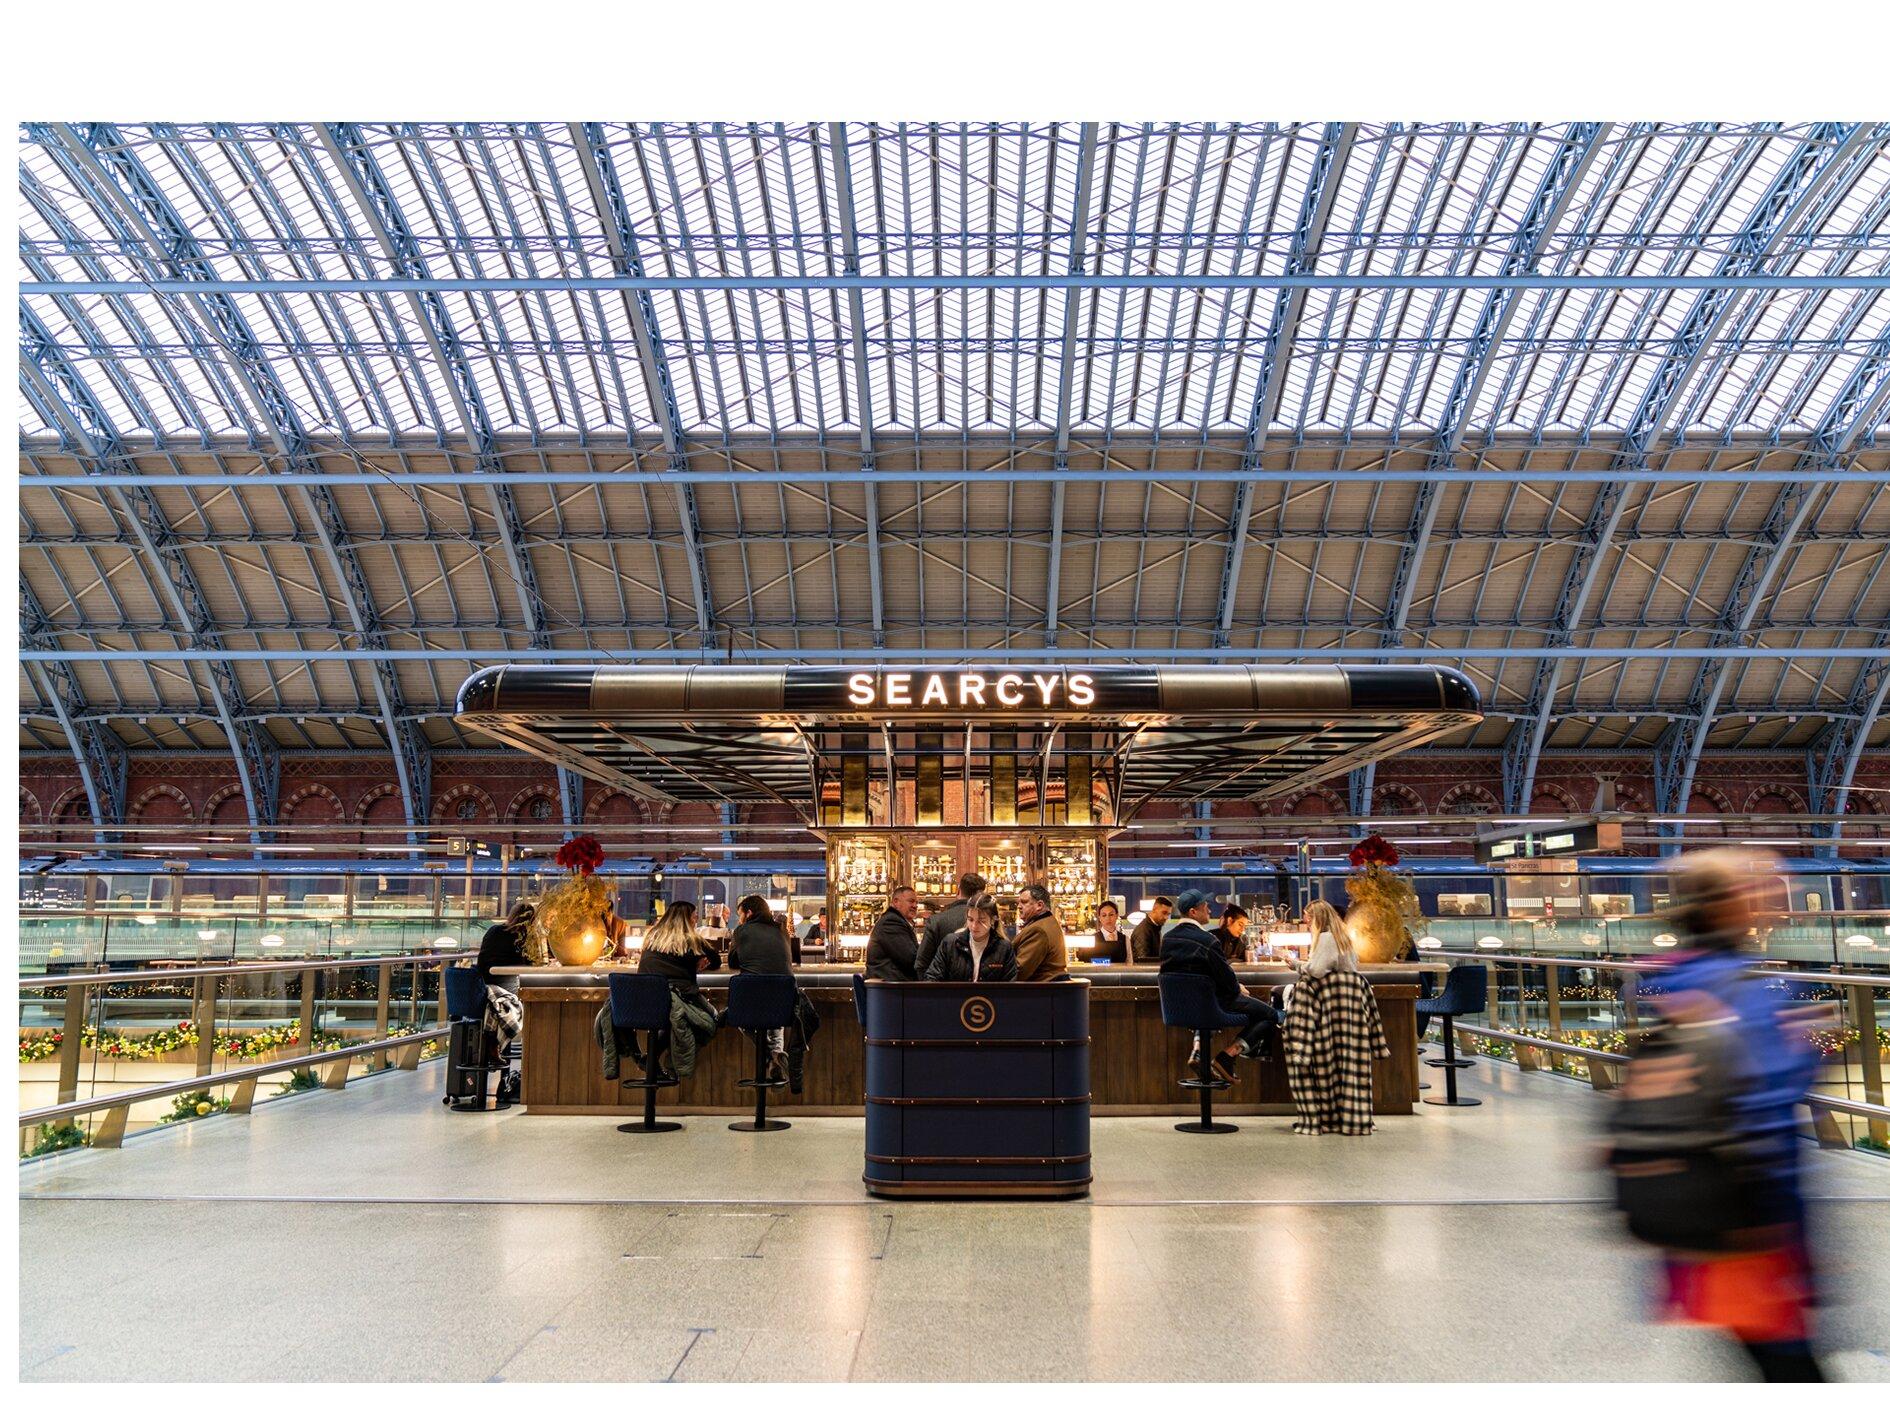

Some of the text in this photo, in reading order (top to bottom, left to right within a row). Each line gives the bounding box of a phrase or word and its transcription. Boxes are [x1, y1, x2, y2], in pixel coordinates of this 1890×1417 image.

[849, 674, 1095, 705] SEARCYS
[453, 841, 460, 851] 5
[970, 1004, 986, 1024] S
